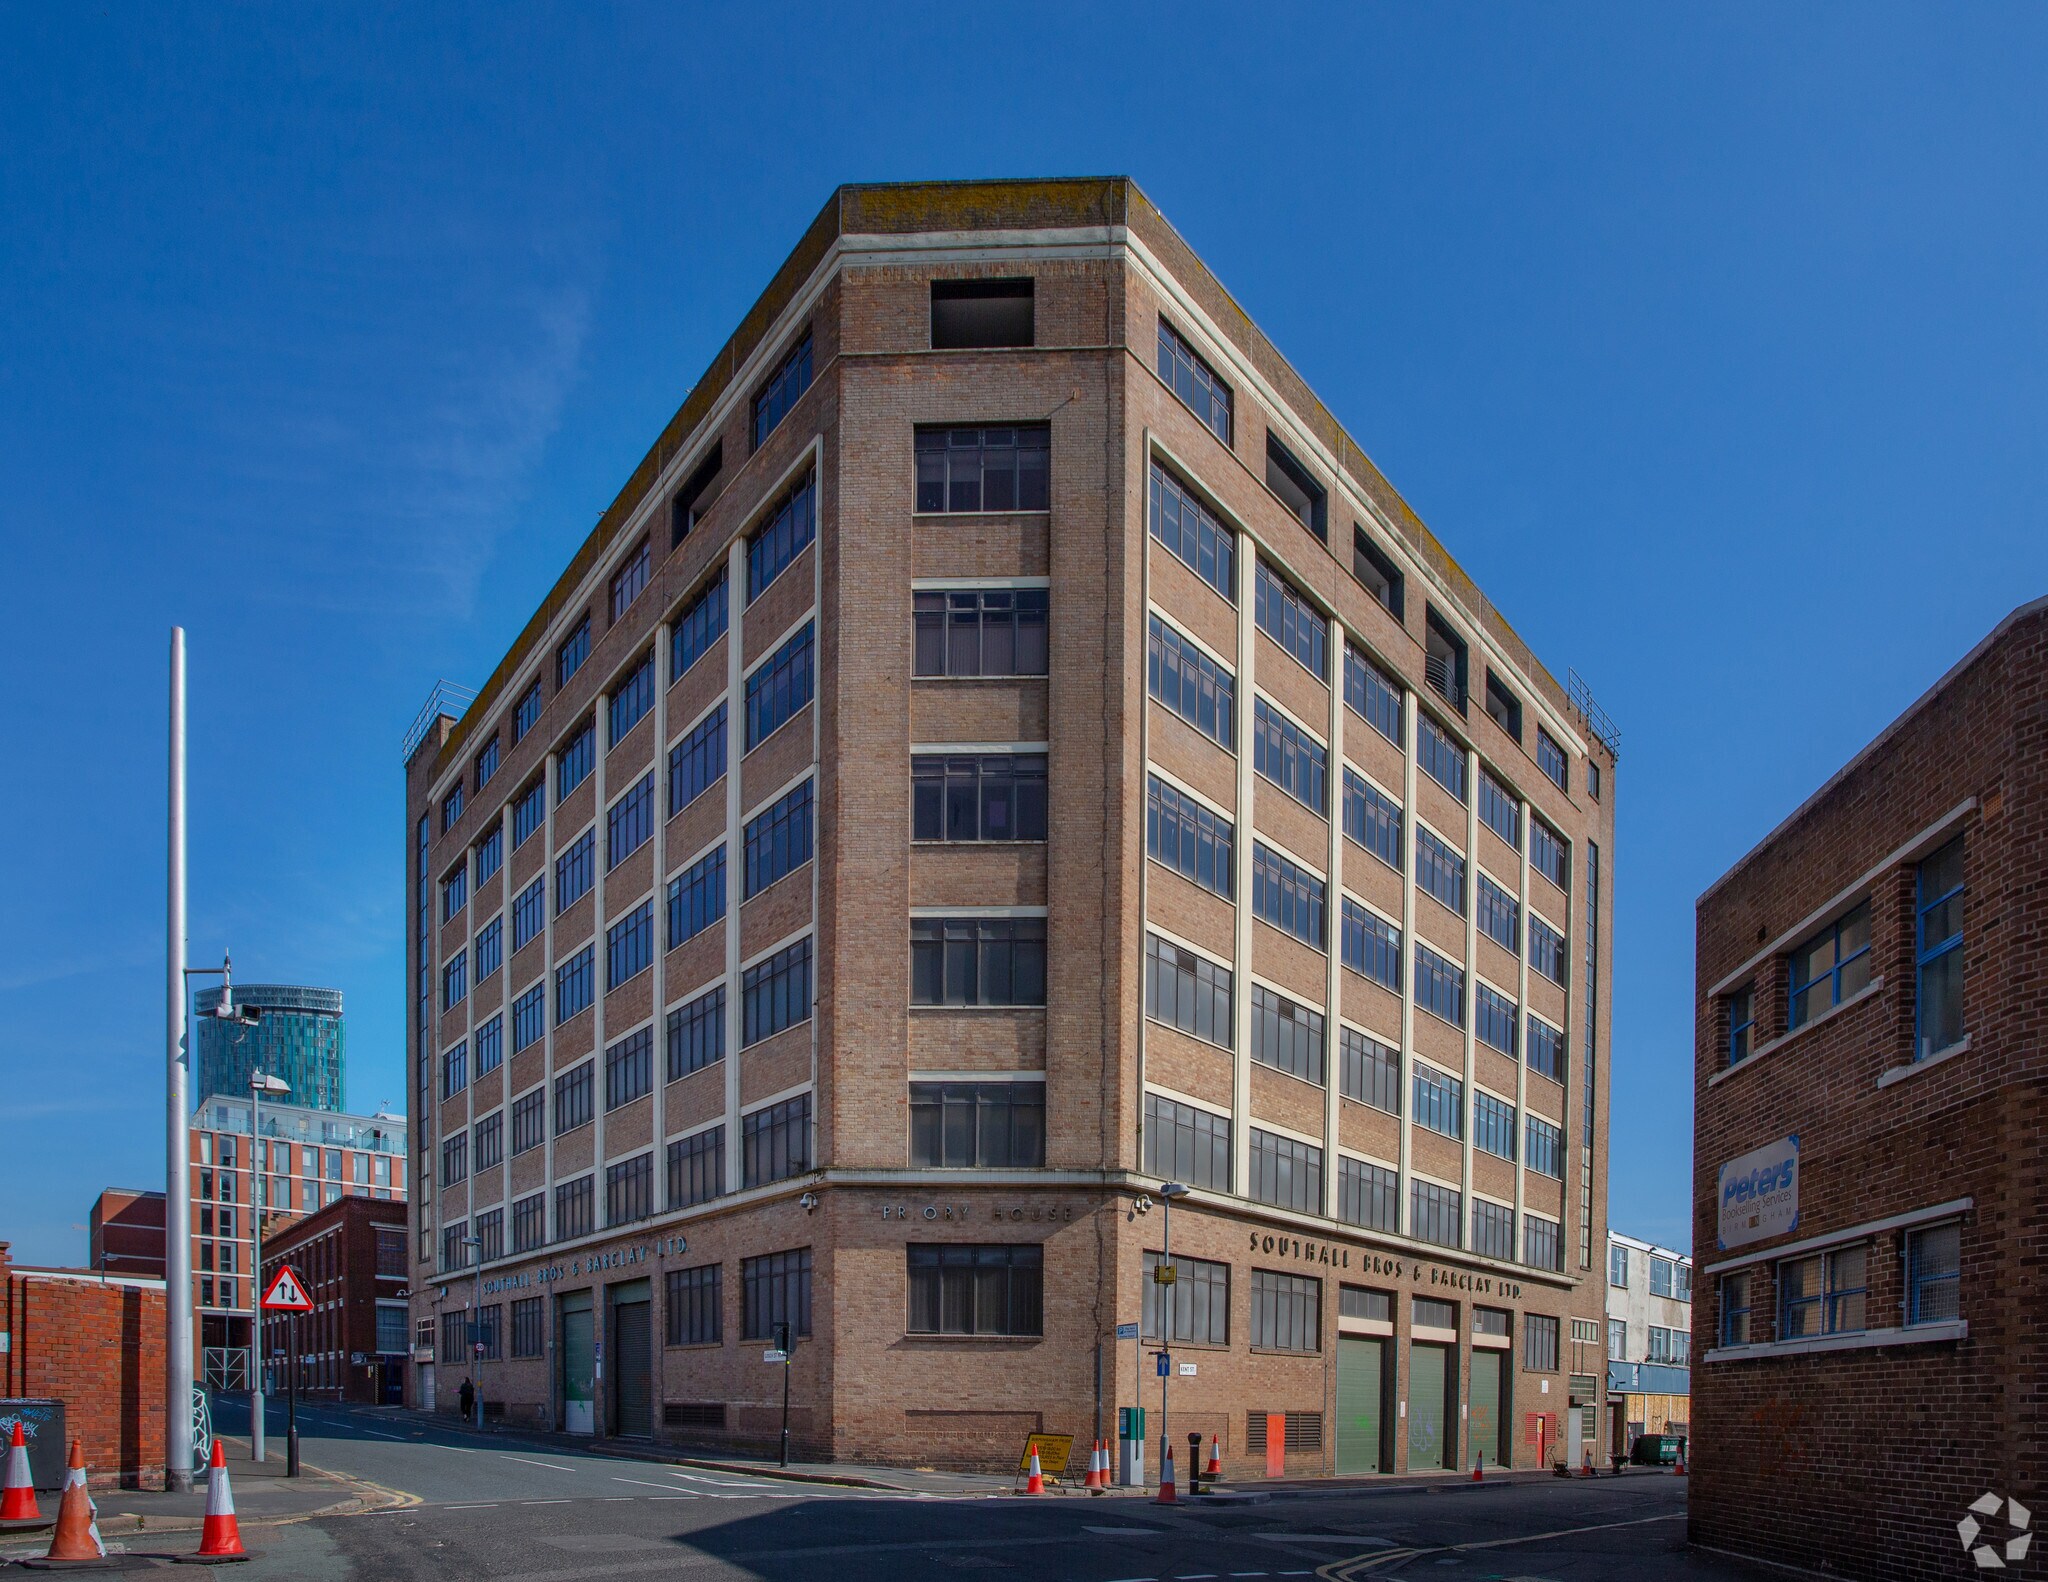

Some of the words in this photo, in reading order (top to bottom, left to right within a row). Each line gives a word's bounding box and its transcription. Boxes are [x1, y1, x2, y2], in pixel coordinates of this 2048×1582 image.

[994, 1207, 1072, 1221] HOUSE
[1722, 1201, 1760, 1220] Bookselling
[1762, 1190, 1792, 1208] Services
[1722, 1206, 1791, 1235] BIRMINGHAM
[482, 1273, 531, 1295] SOUTHALL
[537, 1266, 564, 1284] BROS
[571, 1262, 580, 1277] &
[586, 1246, 647, 1273] BARCLAY
[1249, 1231, 1350, 1268] SOUTHALL
[1363, 1254, 1403, 1279] BROS
[1413, 1265, 1421, 1282] &
[1431, 1268, 1491, 1293] BARCLAY
